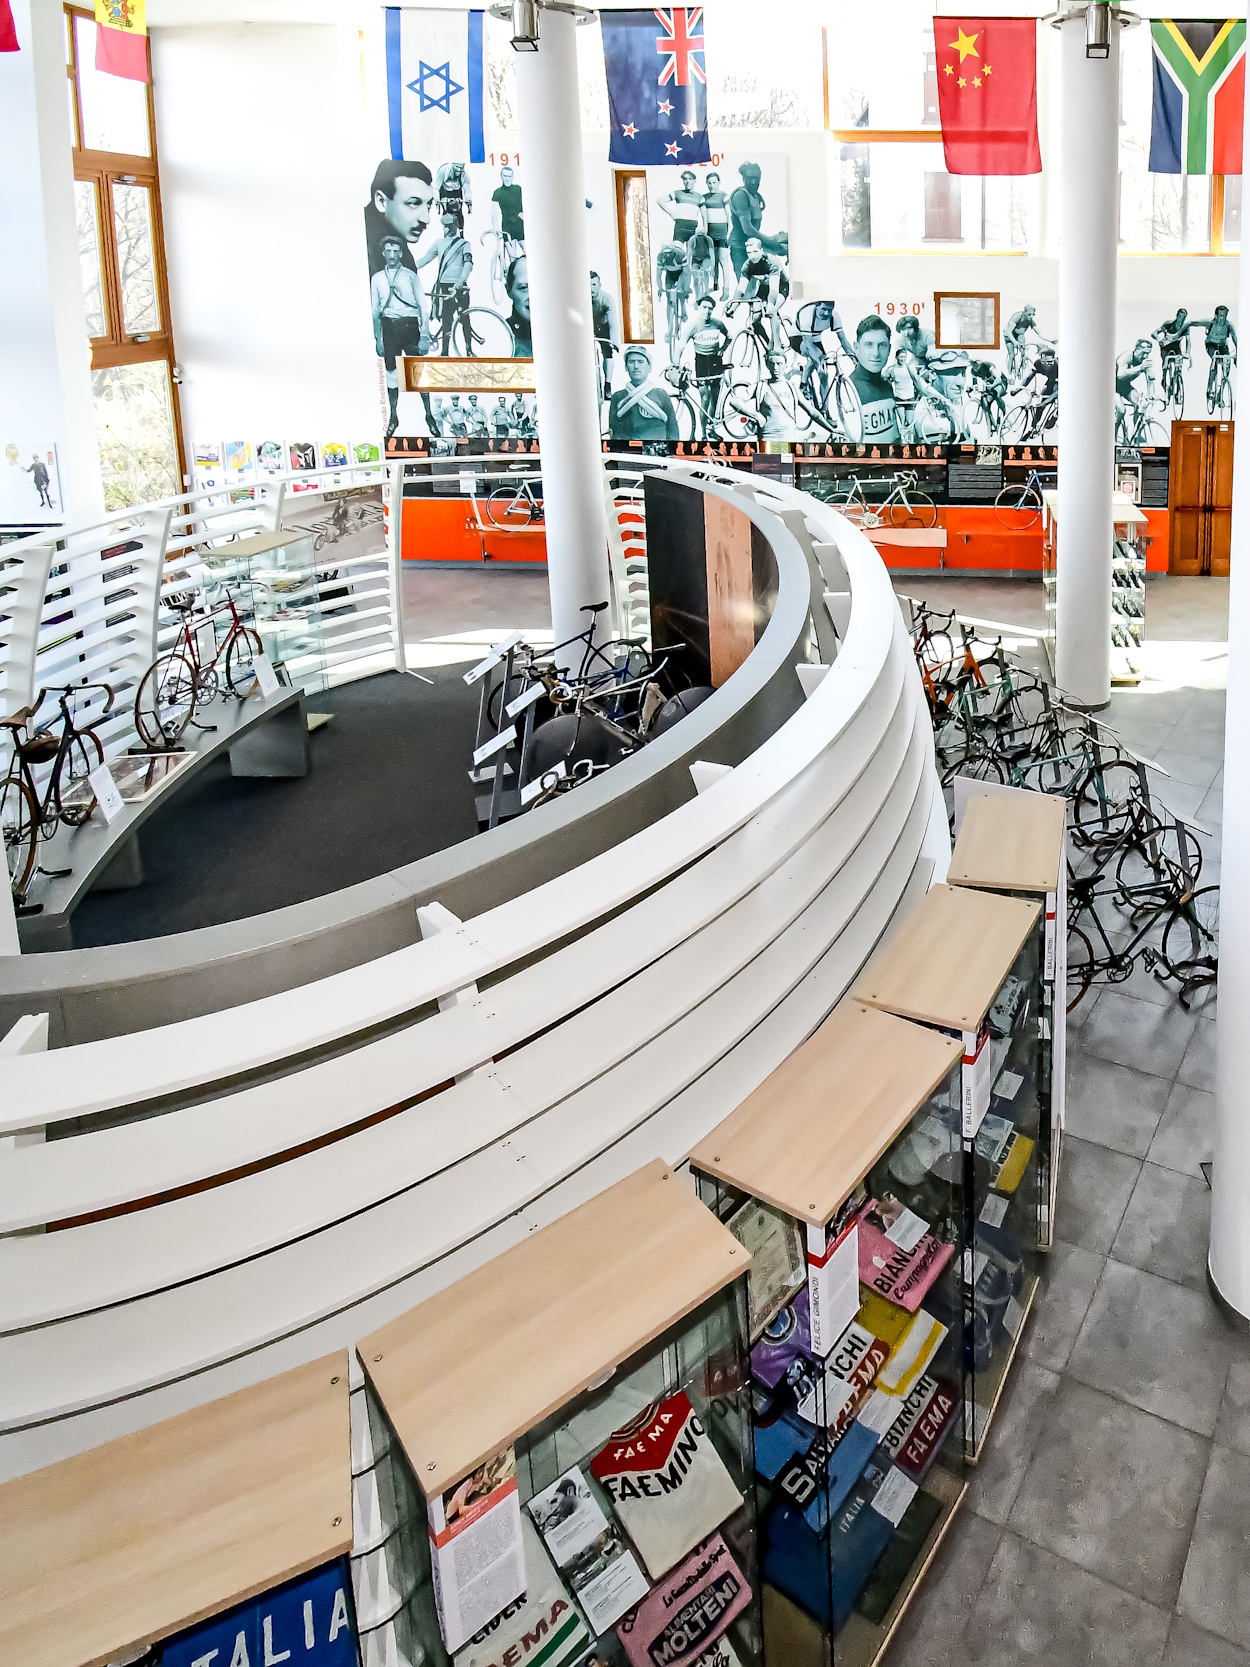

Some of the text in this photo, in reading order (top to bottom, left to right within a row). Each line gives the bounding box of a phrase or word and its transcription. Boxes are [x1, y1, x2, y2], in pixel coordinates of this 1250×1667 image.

[811, 1276, 822, 1350] FELICE GIMONDI
[613, 1413, 674, 1461] FAEMA
[885, 1374, 934, 1449] BIANCHI
[906, 1394, 953, 1464] FAEMA
[838, 1495, 866, 1533] ITALIA
[652, 1577, 739, 1667] MOLTENI
